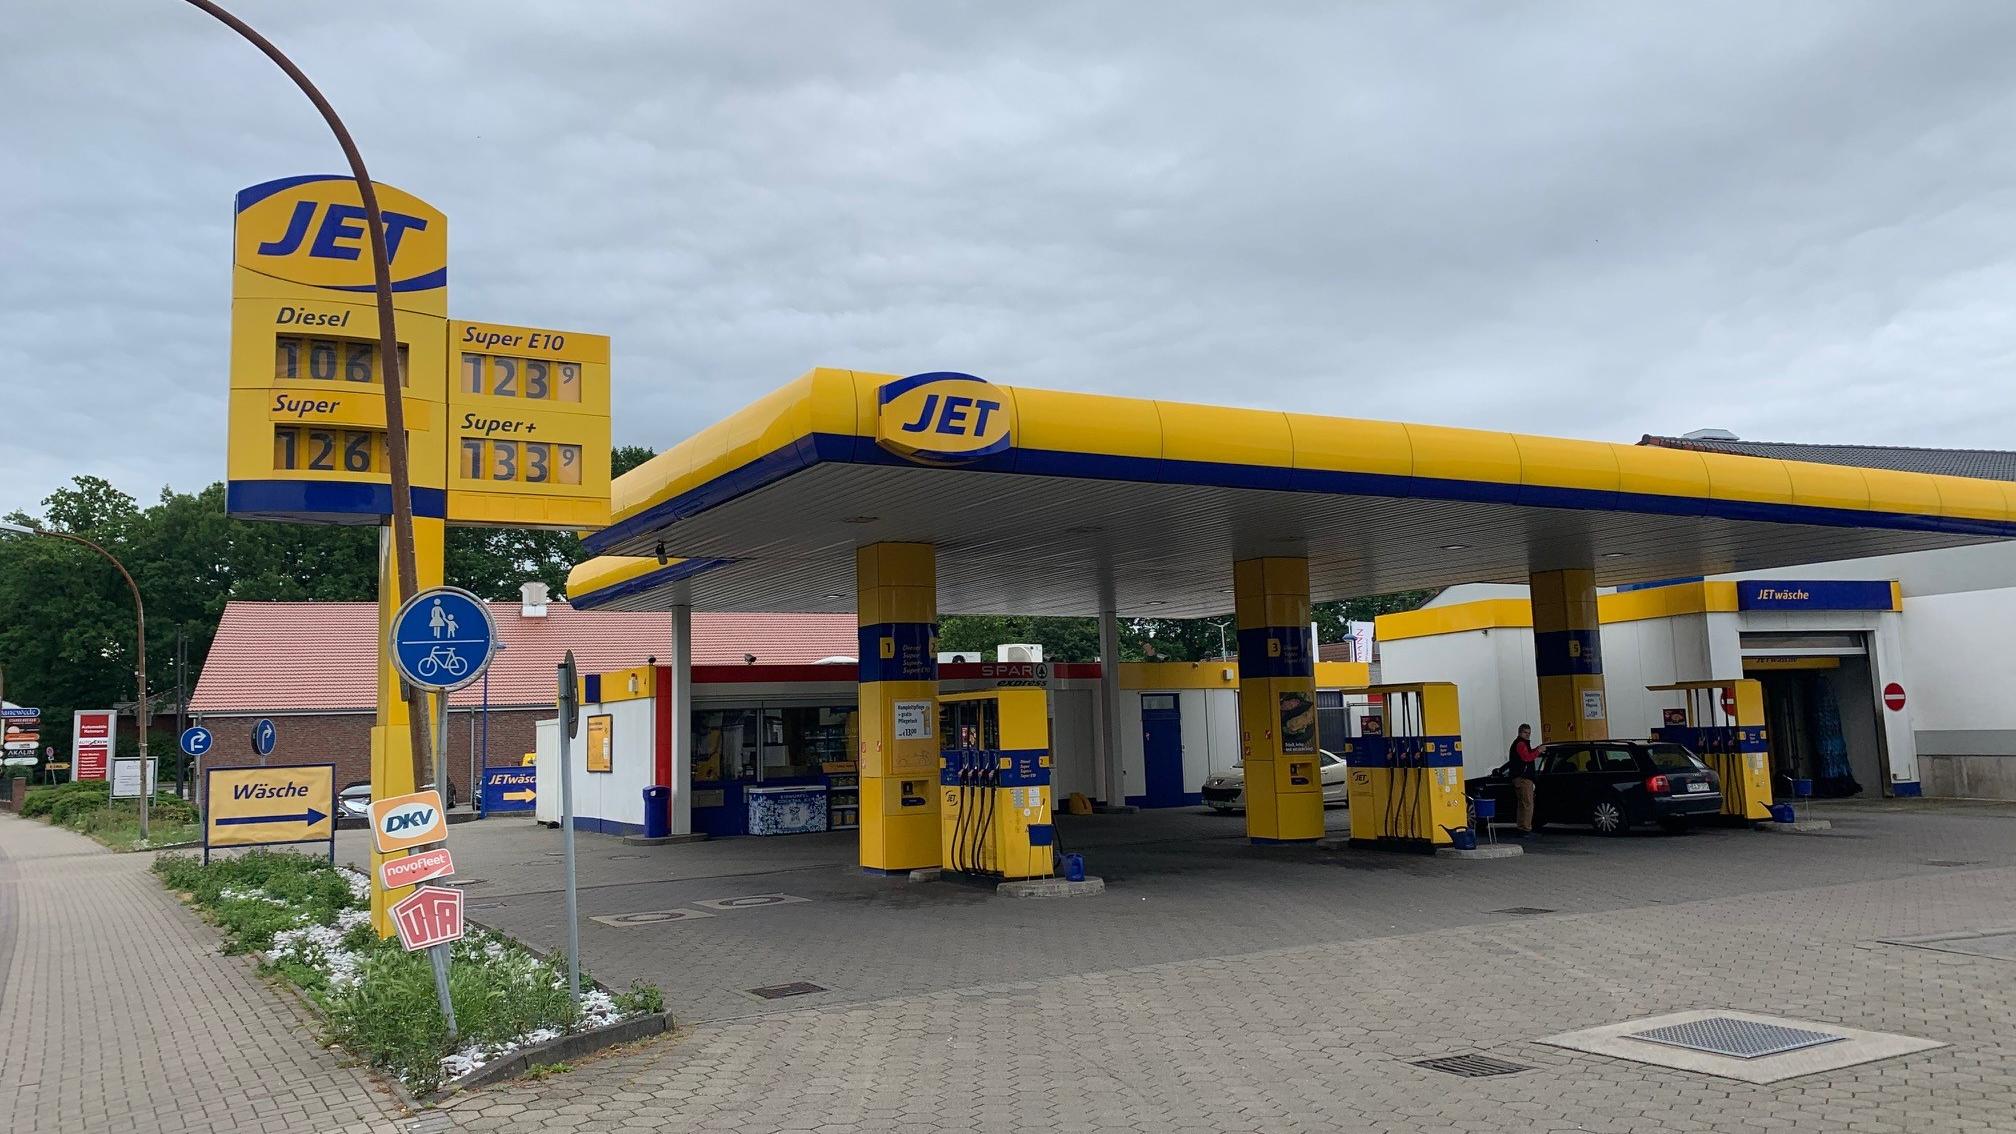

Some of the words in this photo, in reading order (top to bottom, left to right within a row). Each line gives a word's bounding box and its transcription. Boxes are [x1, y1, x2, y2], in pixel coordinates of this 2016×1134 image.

[257, 201, 428, 265] JET
[276, 307, 350, 328] Diesel
[462, 326, 523, 350] Super
[528, 333, 565, 351] E10
[278, 341, 373, 383] 106
[272, 394, 341, 418] Super
[901, 394, 1000, 438] JET
[461, 413, 537, 435] Super+
[276, 430, 371, 473] 126
[1757, 588, 1810, 600] JETwäsche
[981, 665, 1032, 677] SPAR
[233, 782, 309, 800] Wäsche
[385, 808, 434, 834] DKV
[398, 888, 458, 945] UTA
